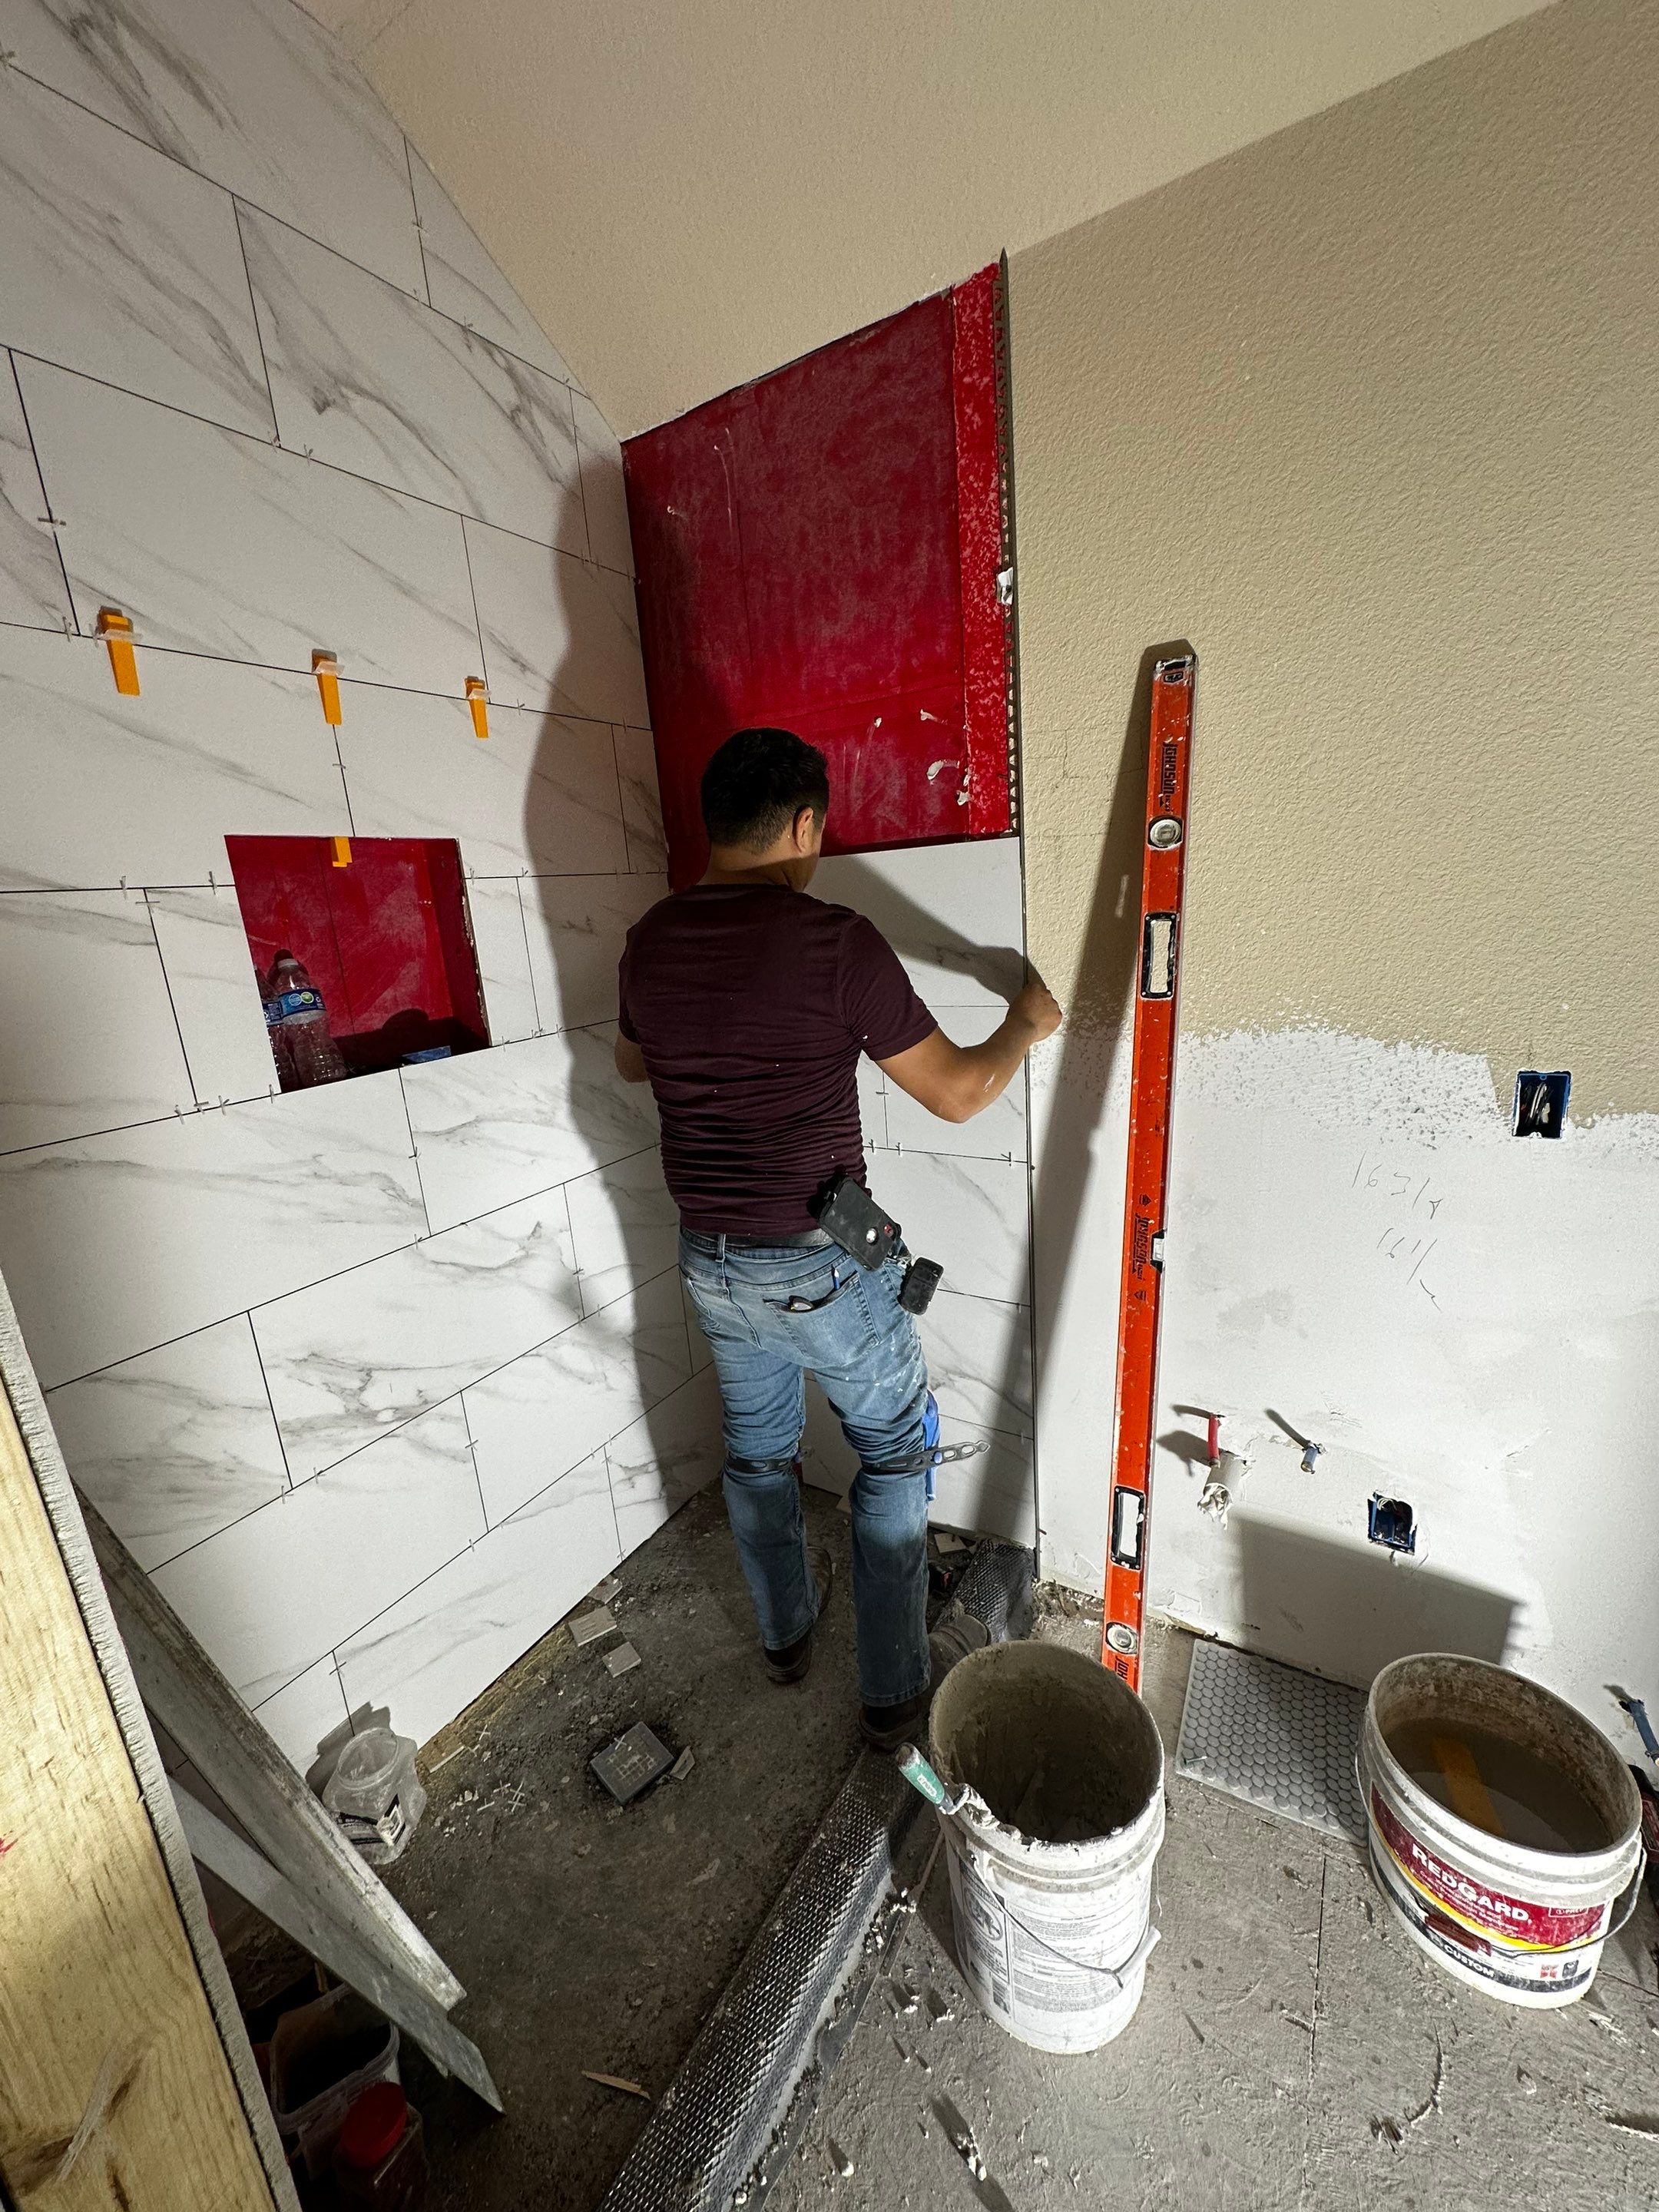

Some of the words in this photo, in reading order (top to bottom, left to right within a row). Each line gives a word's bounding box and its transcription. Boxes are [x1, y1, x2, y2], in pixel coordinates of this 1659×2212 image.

[1115, 1656, 1129, 1680] JOH
[1412, 1843, 1529, 1922] REDGARD
[1444, 1944, 1495, 1978] CUSTOM
